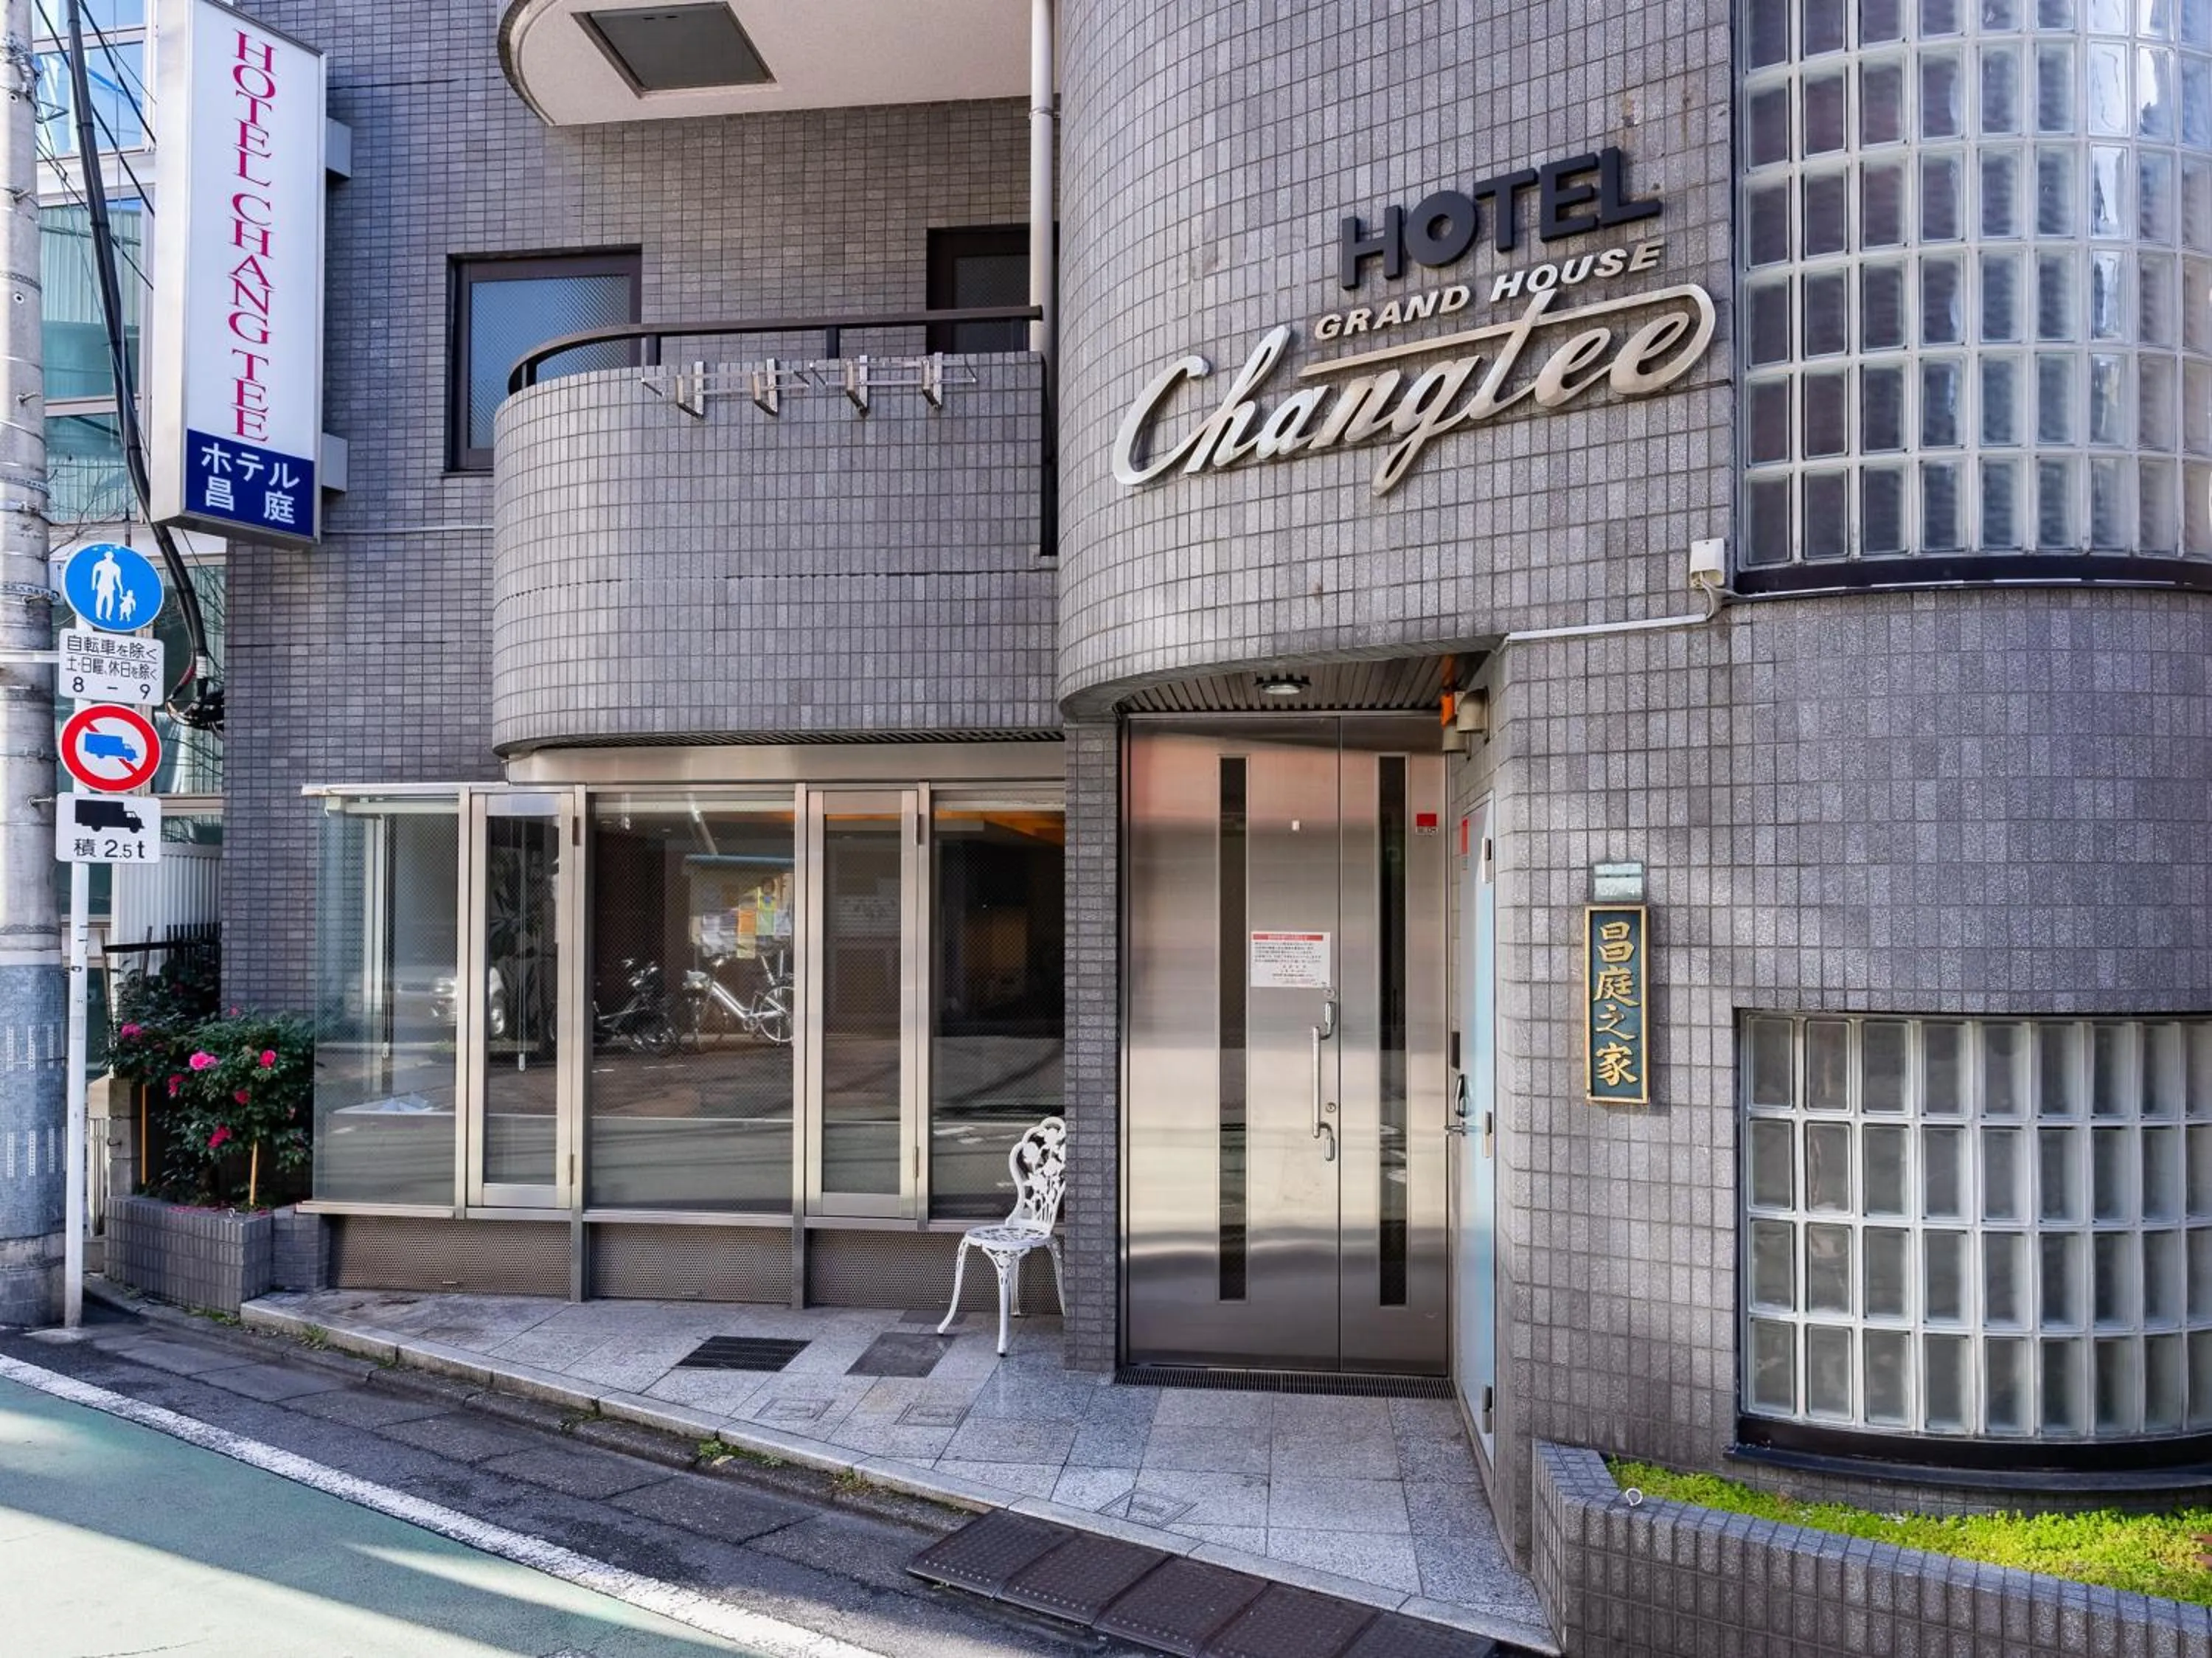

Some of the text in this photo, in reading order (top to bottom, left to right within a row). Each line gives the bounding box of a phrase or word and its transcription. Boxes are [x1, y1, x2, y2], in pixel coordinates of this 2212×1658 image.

[233, 29, 277, 187] HOTEL
[1341, 146, 1663, 291] HOTEL
[1314, 238, 1669, 341] GRAND HOUSE
[1112, 285, 1717, 496] Changtee
[201, 443, 300, 489] ホテル
[67, 635, 157, 660] 自転車を除く
[72, 676, 85, 693] 8
[139, 683, 151, 699] 9
[1593, 921, 1641, 1087] 昌庭之家
